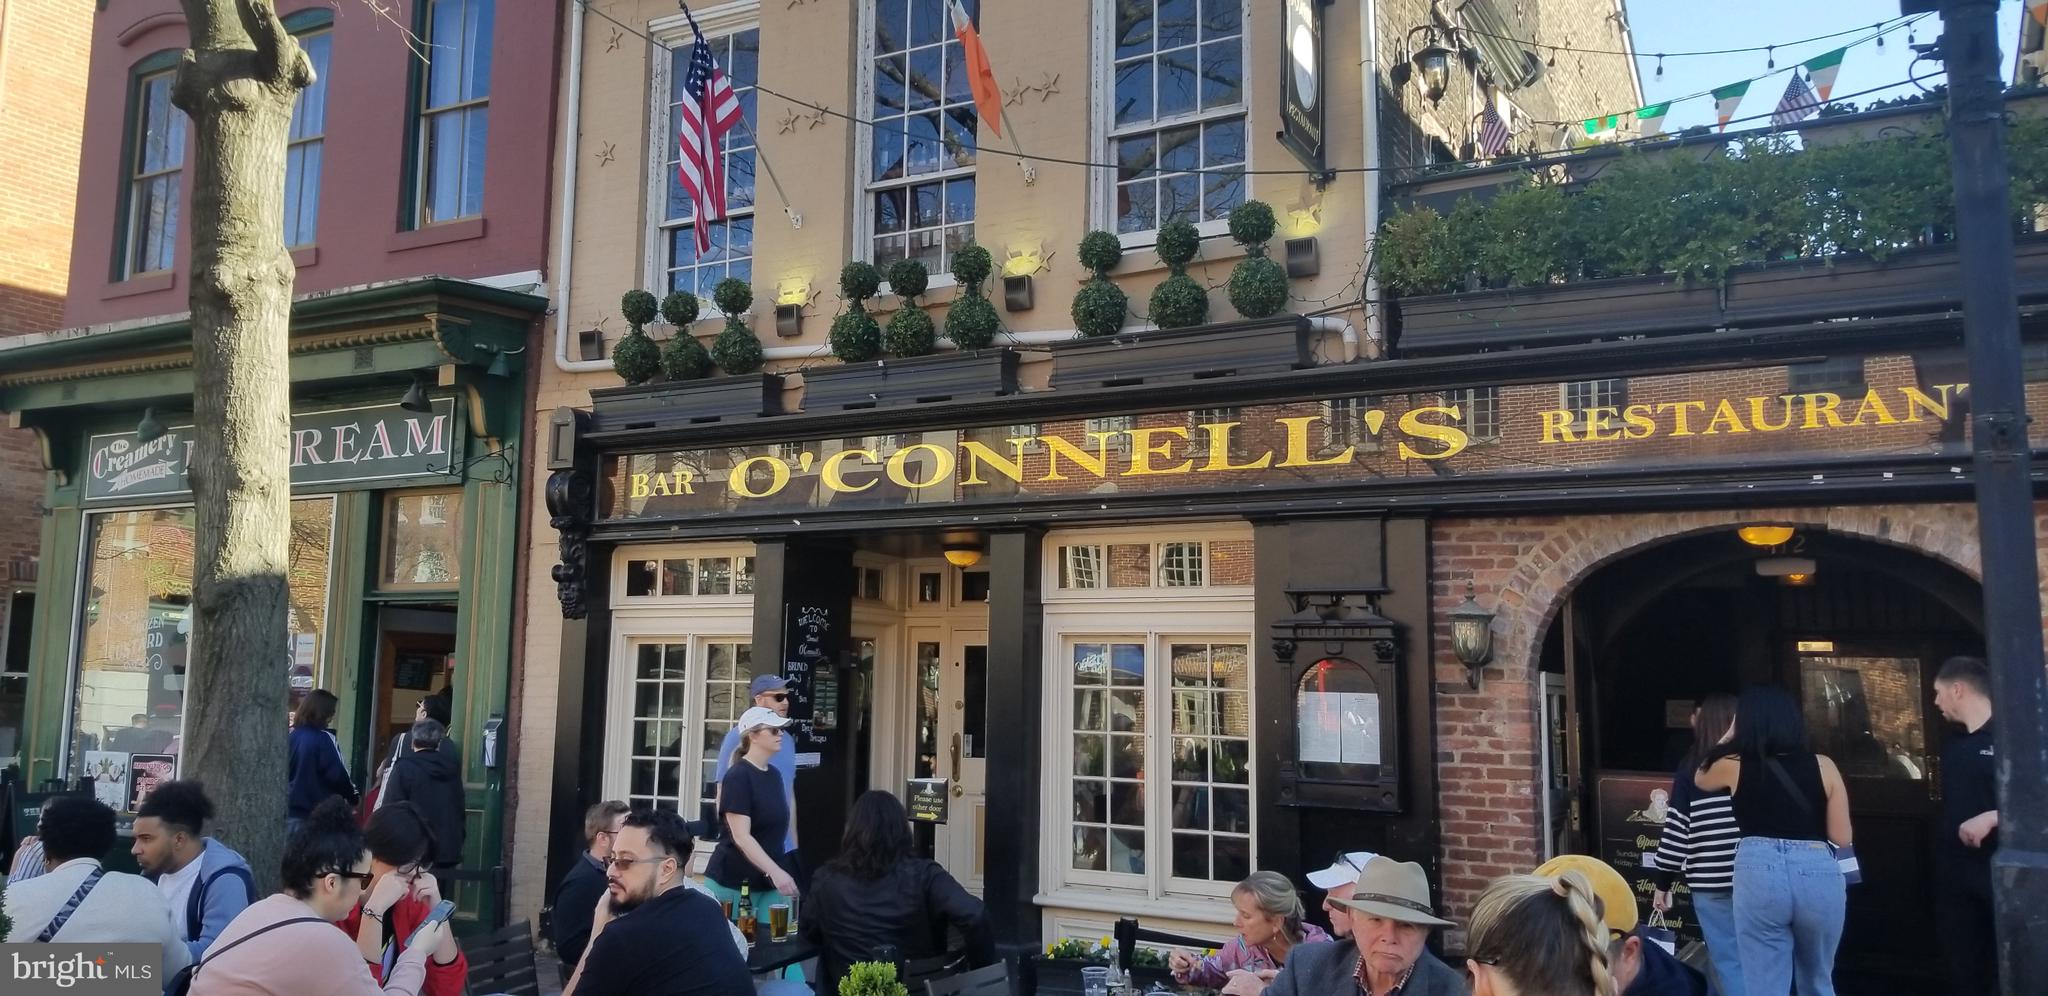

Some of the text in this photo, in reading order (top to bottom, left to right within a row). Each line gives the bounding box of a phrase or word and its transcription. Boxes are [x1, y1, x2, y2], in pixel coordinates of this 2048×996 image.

[290, 415, 448, 467] REAM
[93, 433, 177, 480] Creamery
[630, 405, 1469, 499] BAR O'CONNELL'S
[798, 613, 830, 631] WELCOME
[914, 794, 932, 802] Please
[928, 804, 943, 812] door
[1636, 834, 1660, 850] Open
[1637, 879, 1657, 893] Hap
